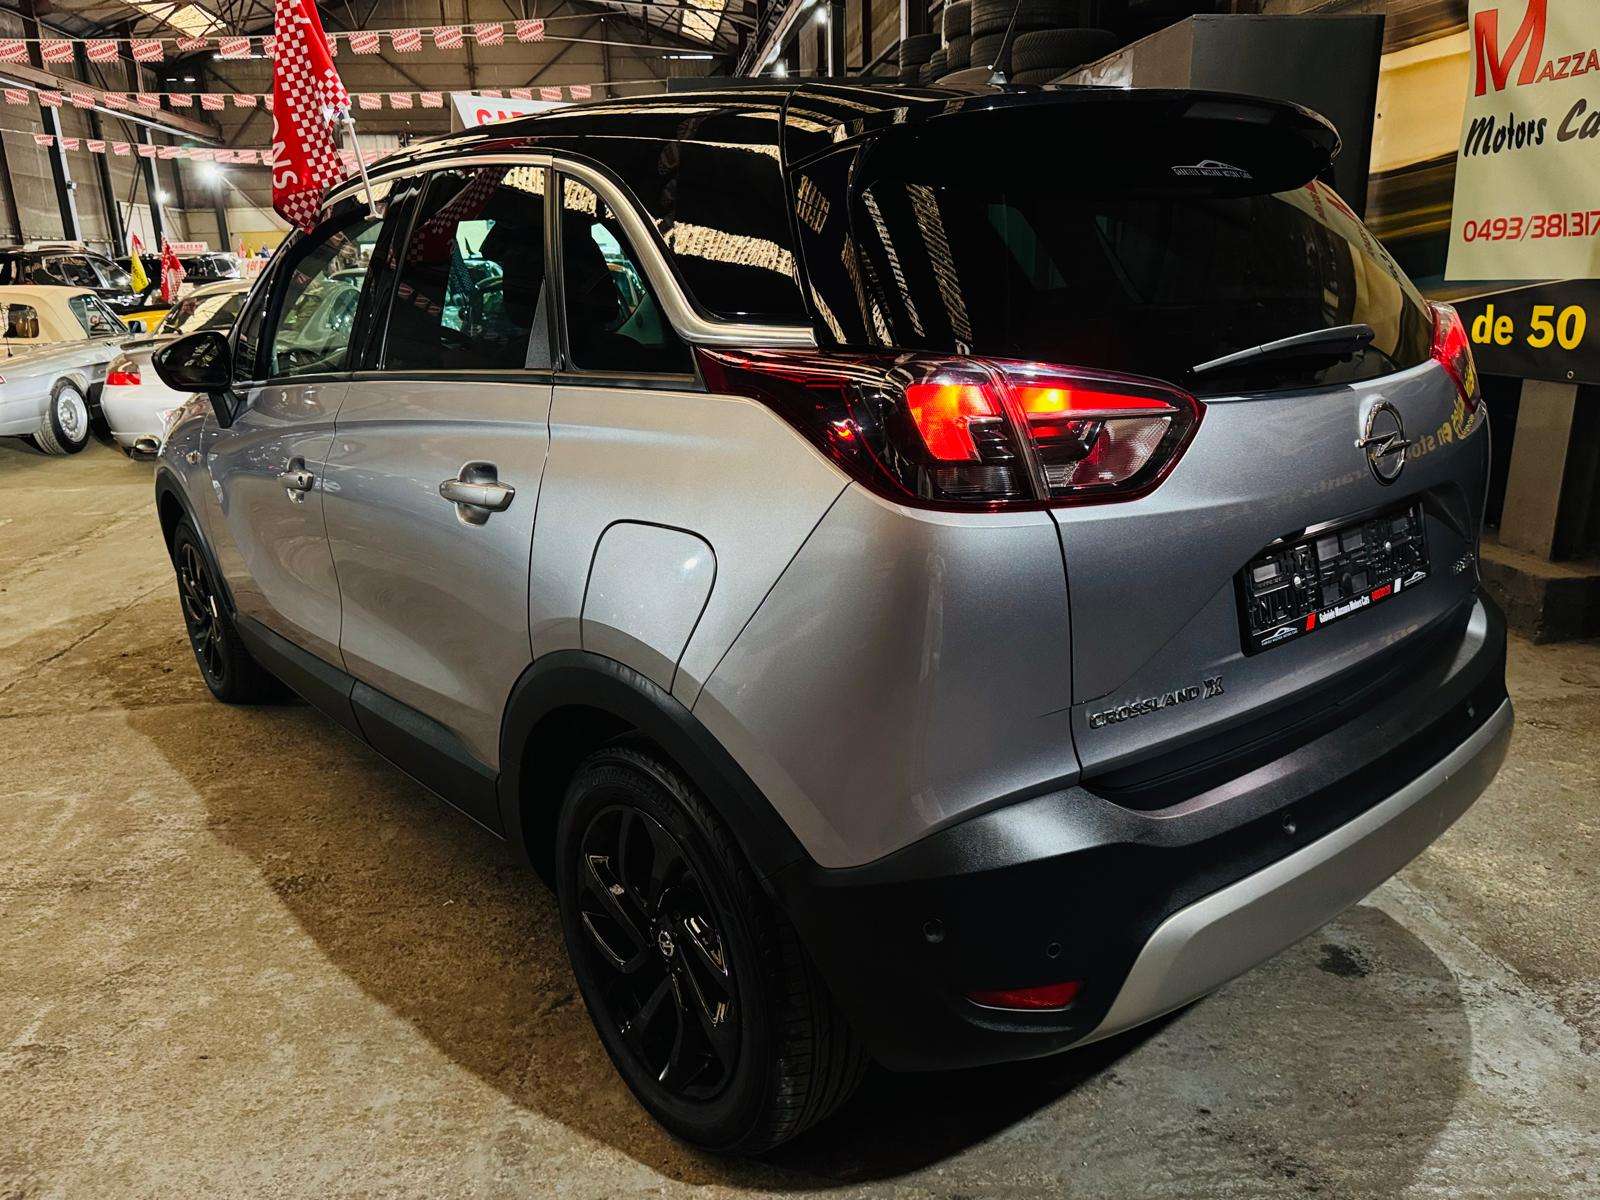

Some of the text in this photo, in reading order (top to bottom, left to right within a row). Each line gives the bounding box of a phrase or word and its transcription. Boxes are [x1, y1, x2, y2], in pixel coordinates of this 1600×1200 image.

[221, 42, 249, 55] OCCASION
[351, 35, 378, 50] OCCASION
[0, 44, 25, 57] CCASION
[44, 44, 72, 58] OCCASION
[88, 43, 117, 58] OCCASION
[133, 43, 161, 59] OCCASION
[1463, 112, 1548, 157] Motors
[1471, 304, 1588, 351] de 50
[1089, 675, 1225, 730] CROSSLAND X
